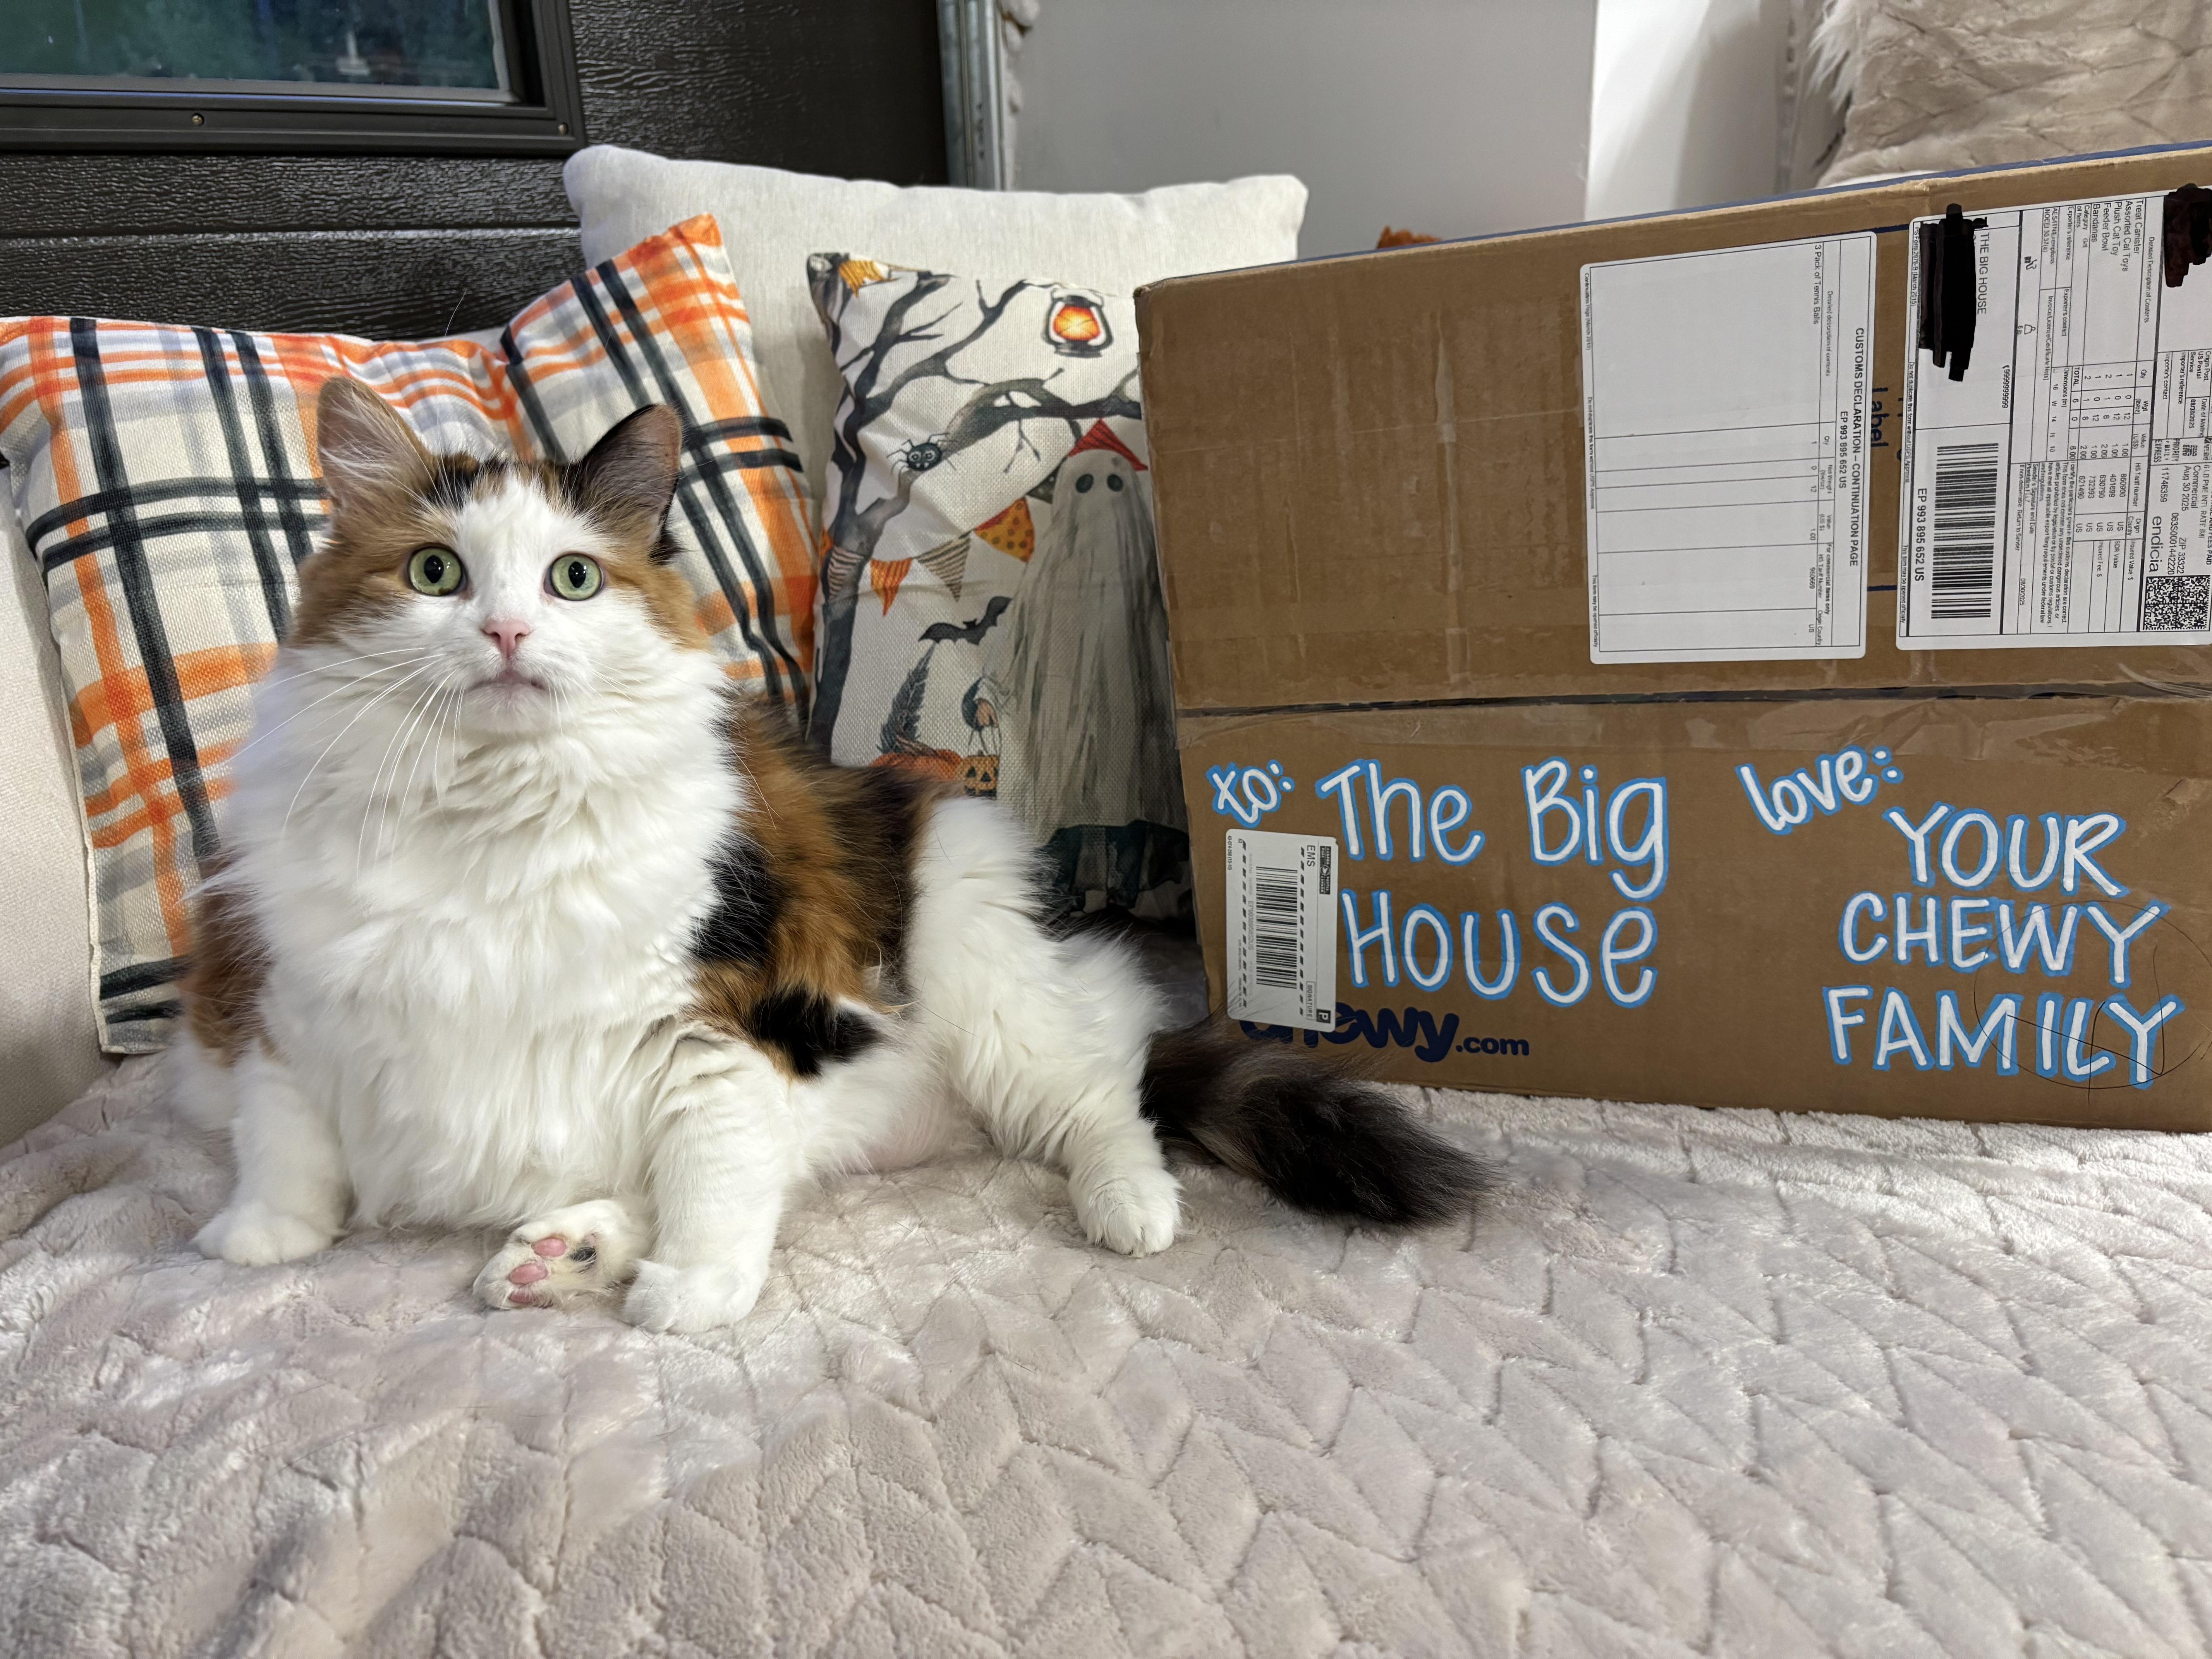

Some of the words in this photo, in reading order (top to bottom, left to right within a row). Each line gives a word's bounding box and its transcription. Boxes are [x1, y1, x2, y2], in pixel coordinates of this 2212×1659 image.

[2081, 204, 2090, 230] Category
[2090, 204, 2100, 242] Bandanas
[2102, 203, 2111, 230] Feeder
[2113, 201, 2122, 224] Plush
[2123, 201, 2133, 235] Assorted
[1979, 232, 1989, 254] THE
[2101, 232, 2110, 251] Bowl
[2110, 240, 2120, 256] Toy
[2133, 222, 2143, 254] Canister
[1978, 256, 1988, 275] BIG
[2120, 252, 2130, 272] Toys
[1976, 277, 1987, 315] HOUSE
[1854, 328, 1863, 379] CUSTOMS
[2188, 351, 2196, 373] Service
[2197, 350, 2203, 360] US
[2071, 367, 2080, 387] TOTAL
[1840, 411, 1848, 422] EP
[1852, 381, 1862, 453] DECLARATION
[2113, 412, 2120, 421] 12
[2124, 412, 2131, 420] 12
[1839, 425, 1848, 440] 993
[2090, 445, 2098, 459] 1.00
[2152, 440, 2162, 463] EXPRESS
[2169, 438, 2181, 462] PRIORITY
[1839, 476, 1846, 488] US
[2182, 465, 2191, 481] Aug
[1917, 488, 1927, 502] EP
[2160, 467, 2169, 503] 11746359
[2182, 482, 2190, 491] 30
[2190, 465, 2201, 508] Commercial
[1850, 463, 1860, 538] CONTINUATION
[2181, 493, 2190, 511] 2025
[1917, 505, 1926, 523] 993
[1916, 526, 1926, 544] 895
[2075, 523, 2083, 533] US
[2086, 522, 2093, 532] US
[2096, 522, 2103, 532] US
[2106, 522, 2113, 532] US
[2117, 521, 2124, 531] US
[1850, 539, 1858, 567] PAGE
[2148, 515, 2165, 573] endicia
[2167, 512, 2179, 575] 063S0001442220
[2178, 537, 2186, 550] ZIP
[1915, 546, 1925, 565] 652
[2176, 552, 2185, 574] 33322
[1914, 567, 1924, 581] US
[1808, 624, 1814, 633] US
[1207, 760, 1294, 827] to:
[1735, 745, 1903, 835] love:
[1317, 759, 1484, 865] The
[1522, 756, 1669, 901] Big
[1306, 845, 1315, 867] EMS
[1882, 802, 2130, 896] YOUR
[1839, 891, 2170, 989] CHEWY
[1822, 985, 2186, 1090] FAMILY
